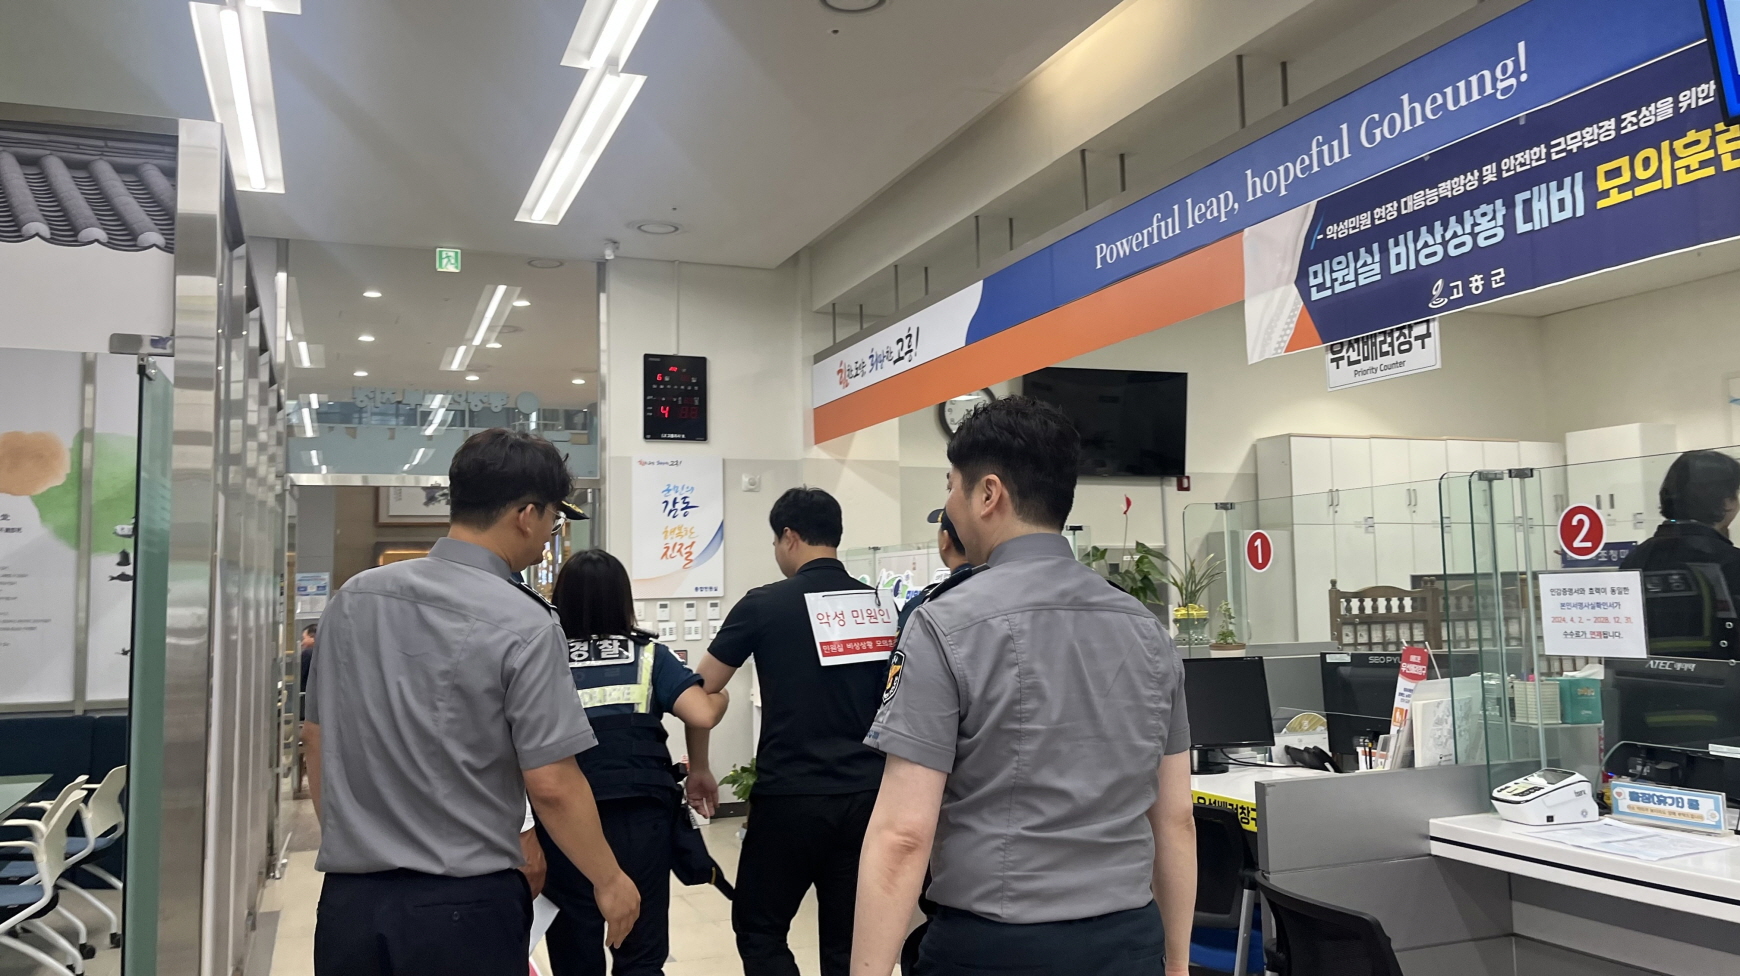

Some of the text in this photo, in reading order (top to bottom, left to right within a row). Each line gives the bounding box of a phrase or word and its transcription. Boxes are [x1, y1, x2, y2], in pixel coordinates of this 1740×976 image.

[1094, 40, 1529, 270] Powerful leap, hopeful Goheung!
[1326, 210, 1372, 240] 악성민원
[1373, 200, 1399, 225] 현장
[1400, 168, 1479, 216] 대응능력향상
[1482, 162, 1498, 185] 및
[1501, 143, 1547, 179] 안전한
[1550, 117, 1616, 161] 근무환경
[1620, 96, 1674, 135] 조성을
[1678, 80, 1716, 114] 위한
[1308, 242, 1382, 301] 민원실
[1388, 198, 1507, 275] 비상상황
[1515, 171, 1585, 235] 대비
[1449, 267, 1506, 300] 고흥군
[1353, 360, 1406, 378] Priority Counter
[660, 405, 670, 418] 4
[662, 495, 700, 519] 감동
[1571, 513, 1592, 548] 2
[660, 540, 696, 570] 친절
[1253, 539, 1264, 564] 1
[816, 608, 892, 628] 악성 민원인
[569, 638, 621, 660] 경찰
[822, 643, 845, 654] 민원실
[846, 640, 874, 651] 비상상황
